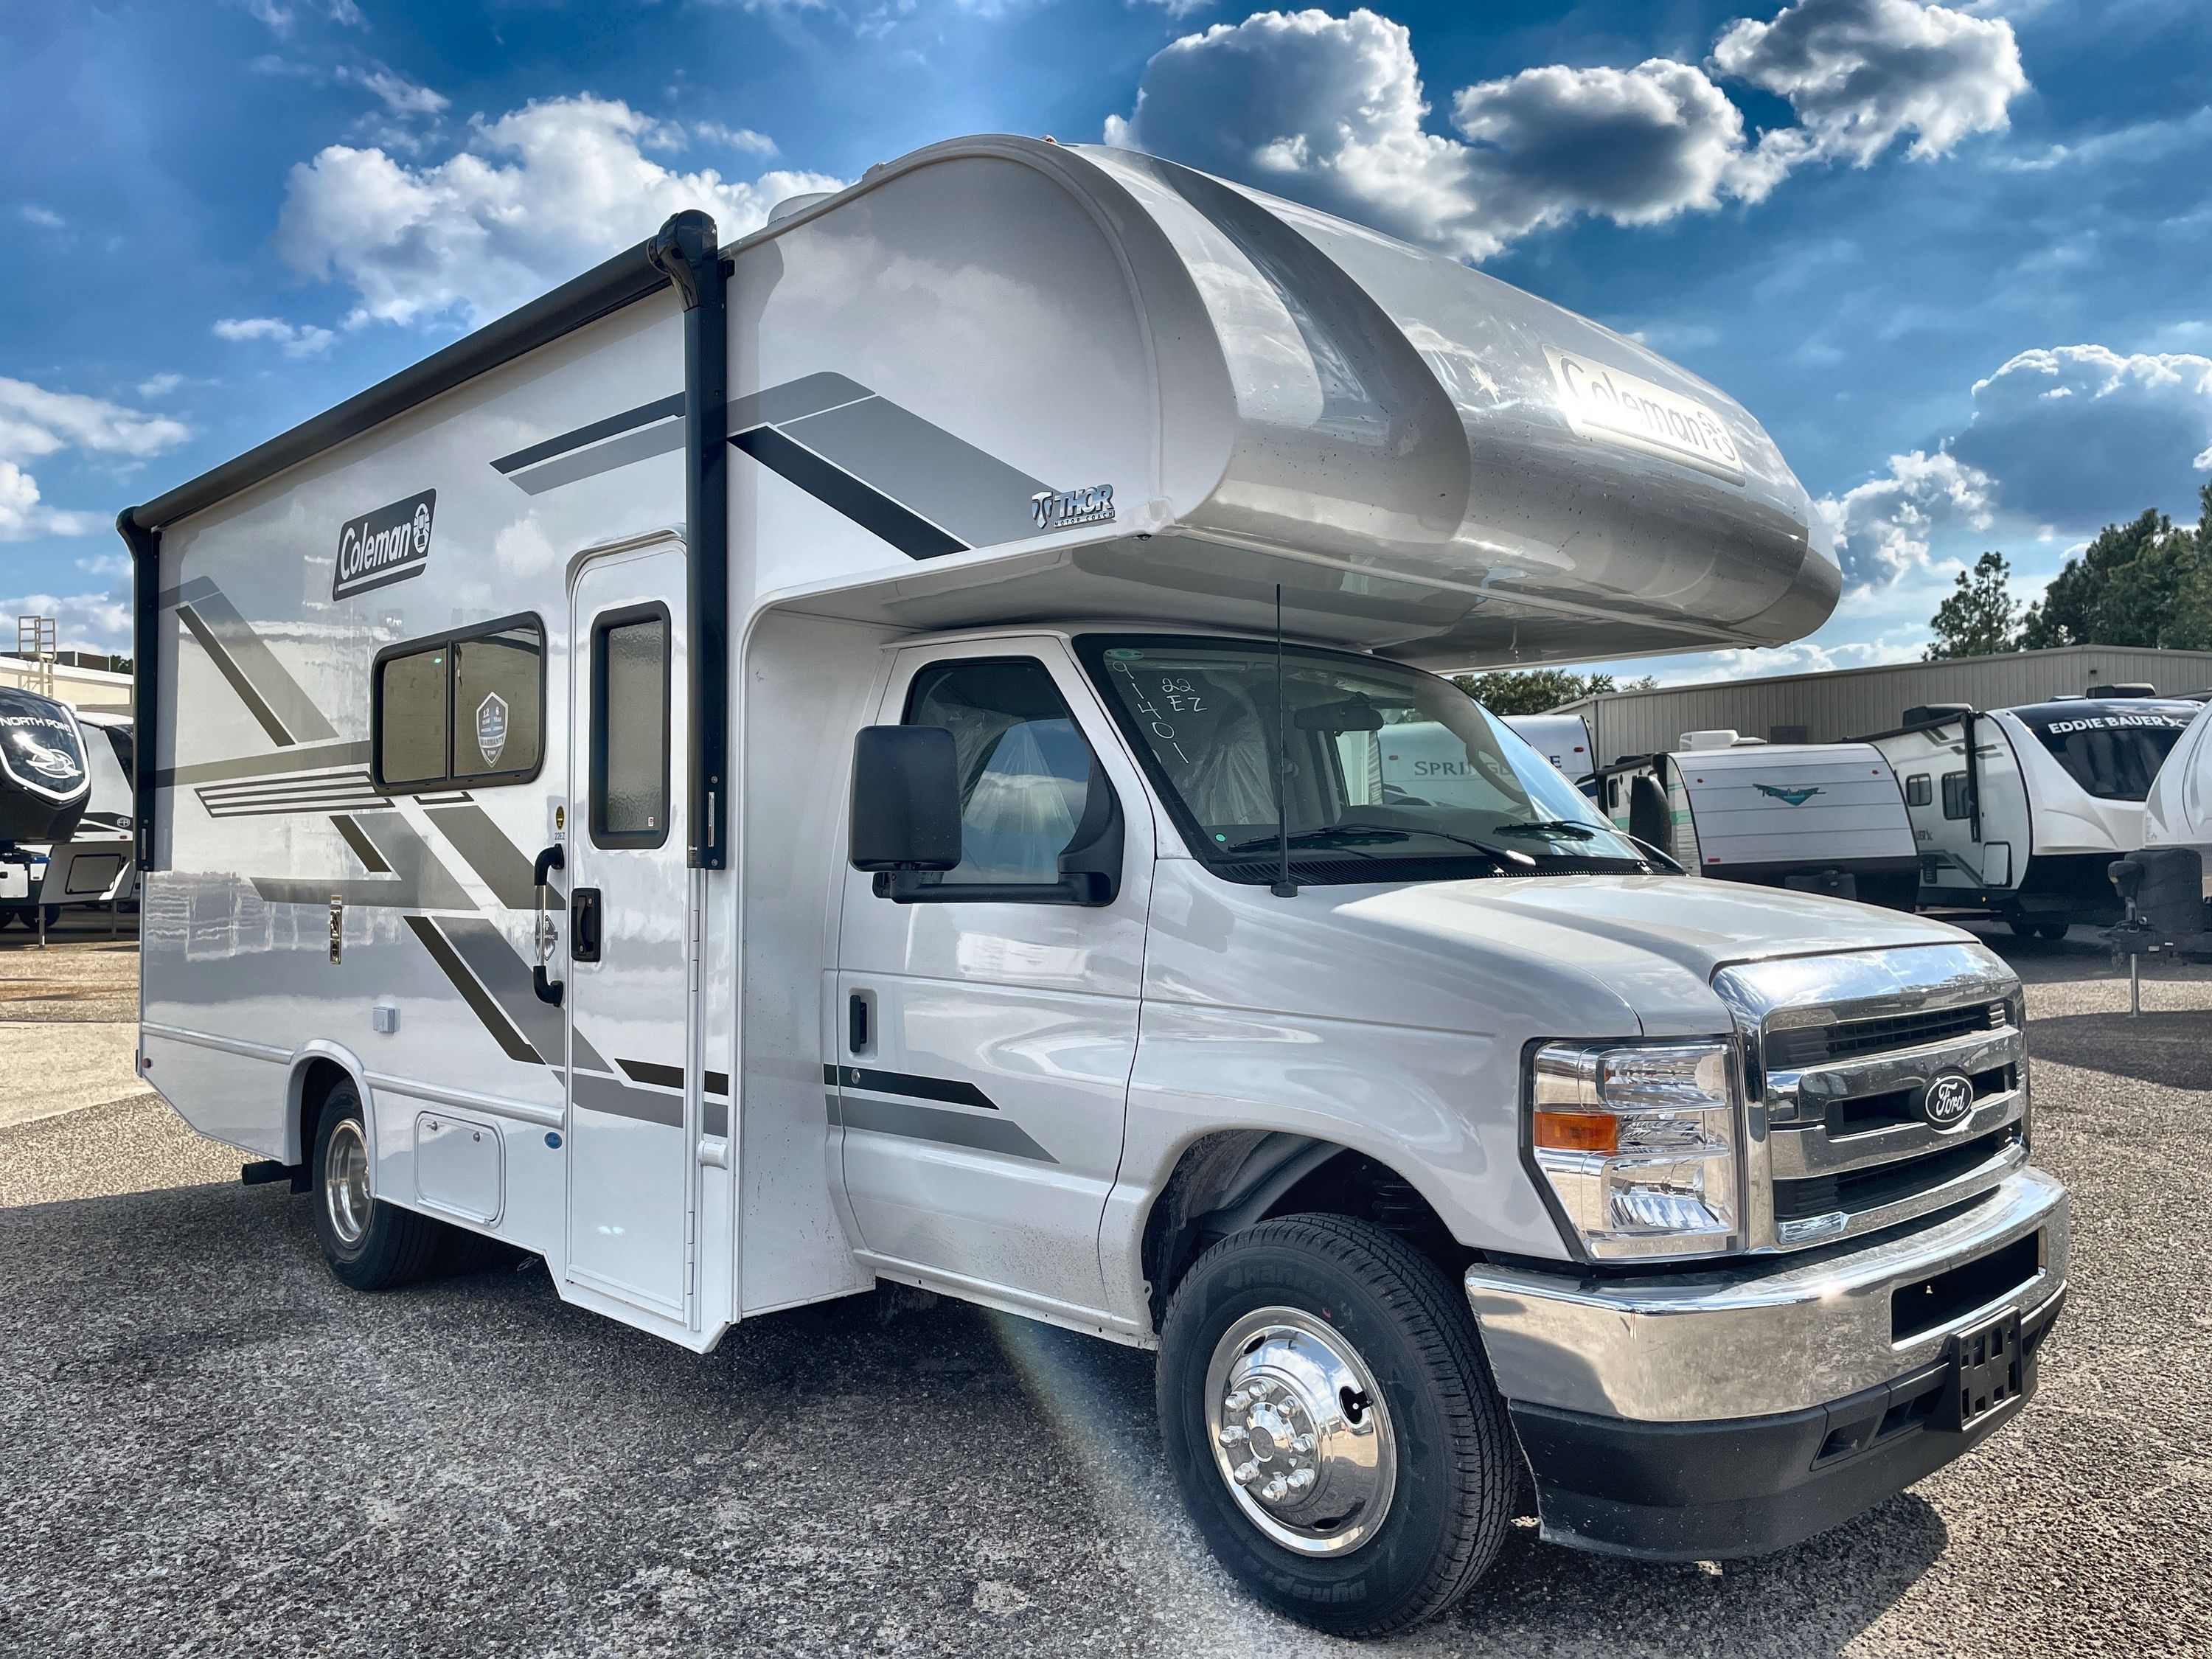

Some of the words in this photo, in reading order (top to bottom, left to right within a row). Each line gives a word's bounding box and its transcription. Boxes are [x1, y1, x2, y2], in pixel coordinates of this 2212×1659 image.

[1560, 356, 1710, 451] Coleman
[1054, 484, 1115, 518] THOR
[1054, 517, 1081, 526] MOTOR
[1085, 511, 1113, 522] COACH
[340, 521, 411, 581] Coleman
[1161, 678, 1195, 693] 22
[1166, 695, 1208, 712] EZ
[0, 717, 45, 727] NORTH
[2048, 717, 2105, 734] EDDIE
[2104, 714, 2166, 727] BAUER
[1935, 1082, 1965, 1116] Ford
